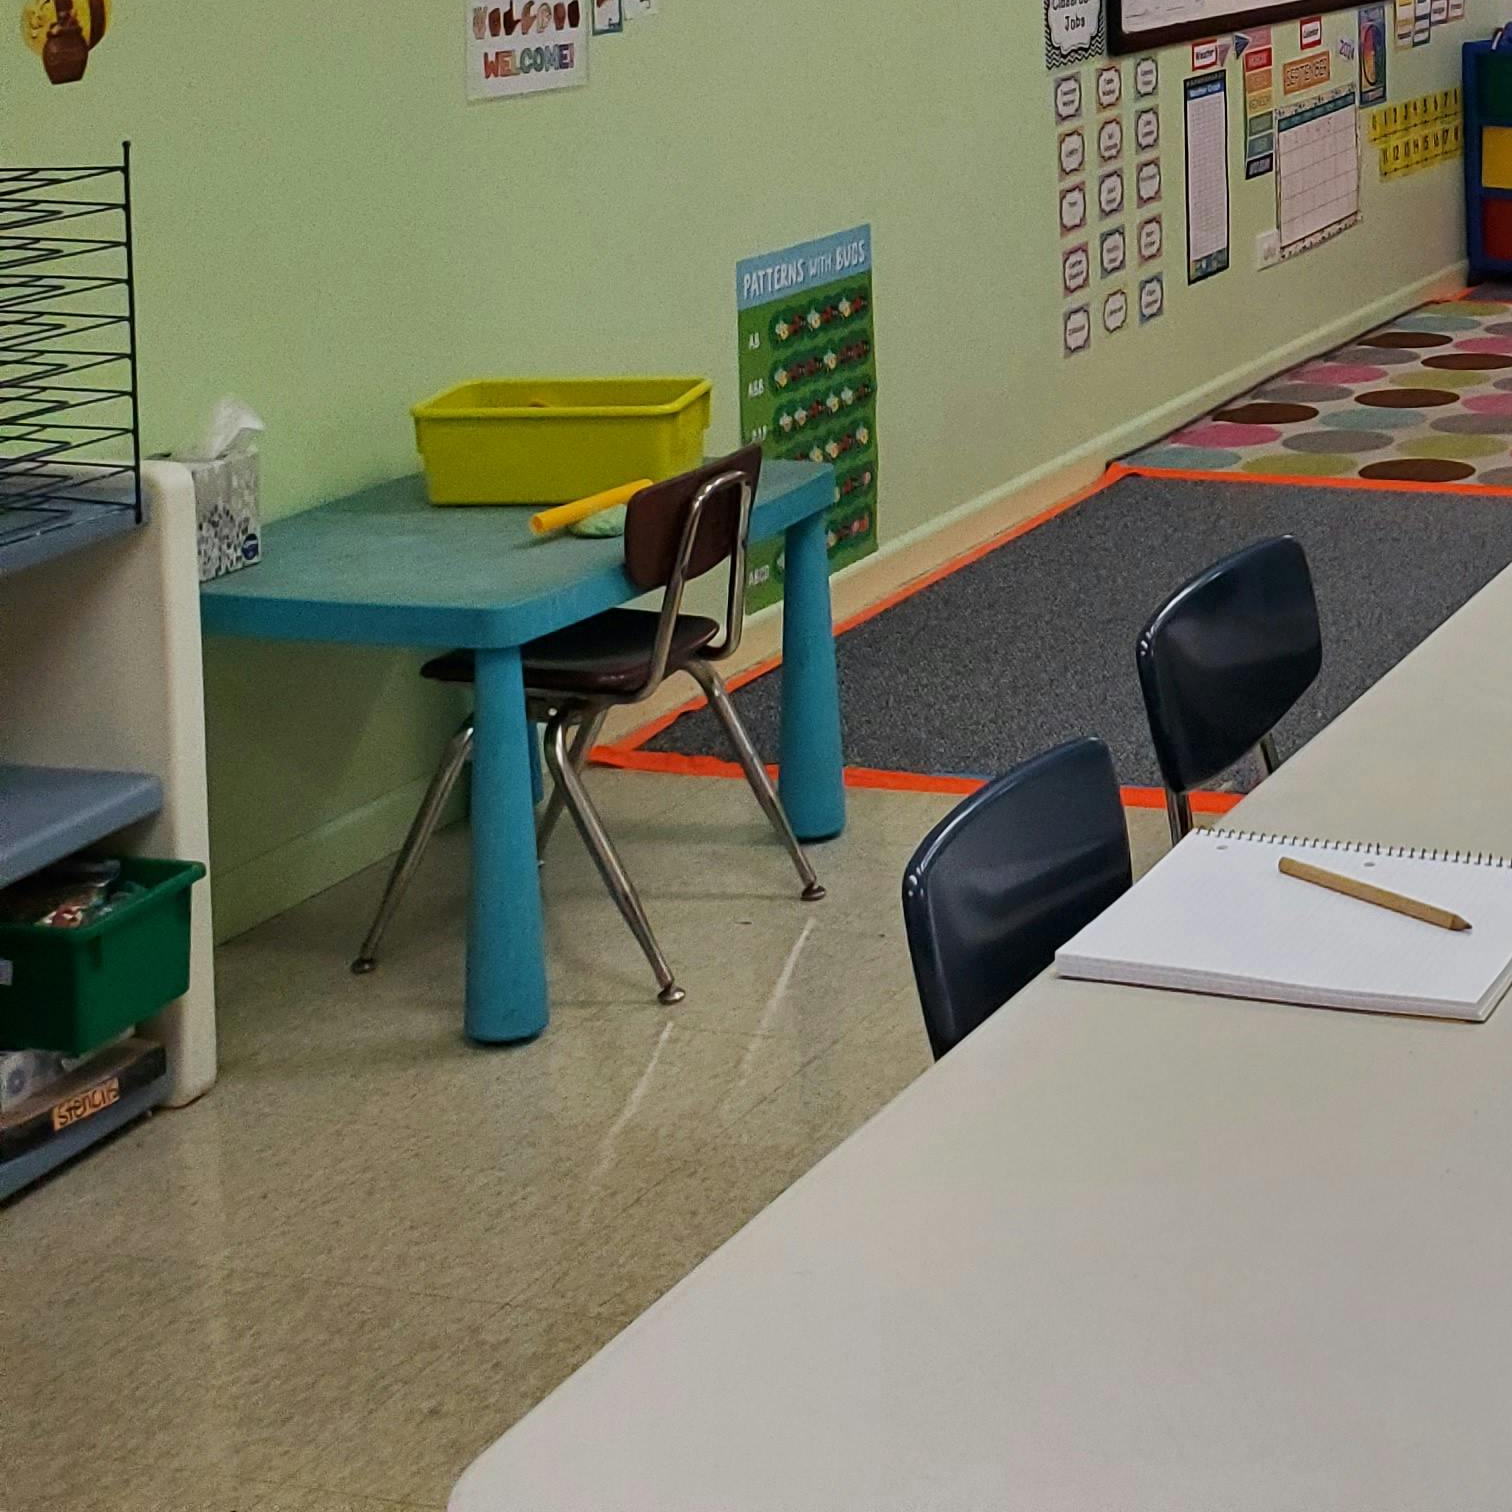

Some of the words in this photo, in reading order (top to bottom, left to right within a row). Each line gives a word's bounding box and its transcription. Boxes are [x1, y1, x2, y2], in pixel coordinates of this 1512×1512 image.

[1064, 12, 1087, 33] Jobs
[483, 42, 574, 79] WELCOME!
[743, 259, 805, 300] PATTERNS
[810, 255, 832, 278] WITH
[835, 239, 866, 271] BUGS
